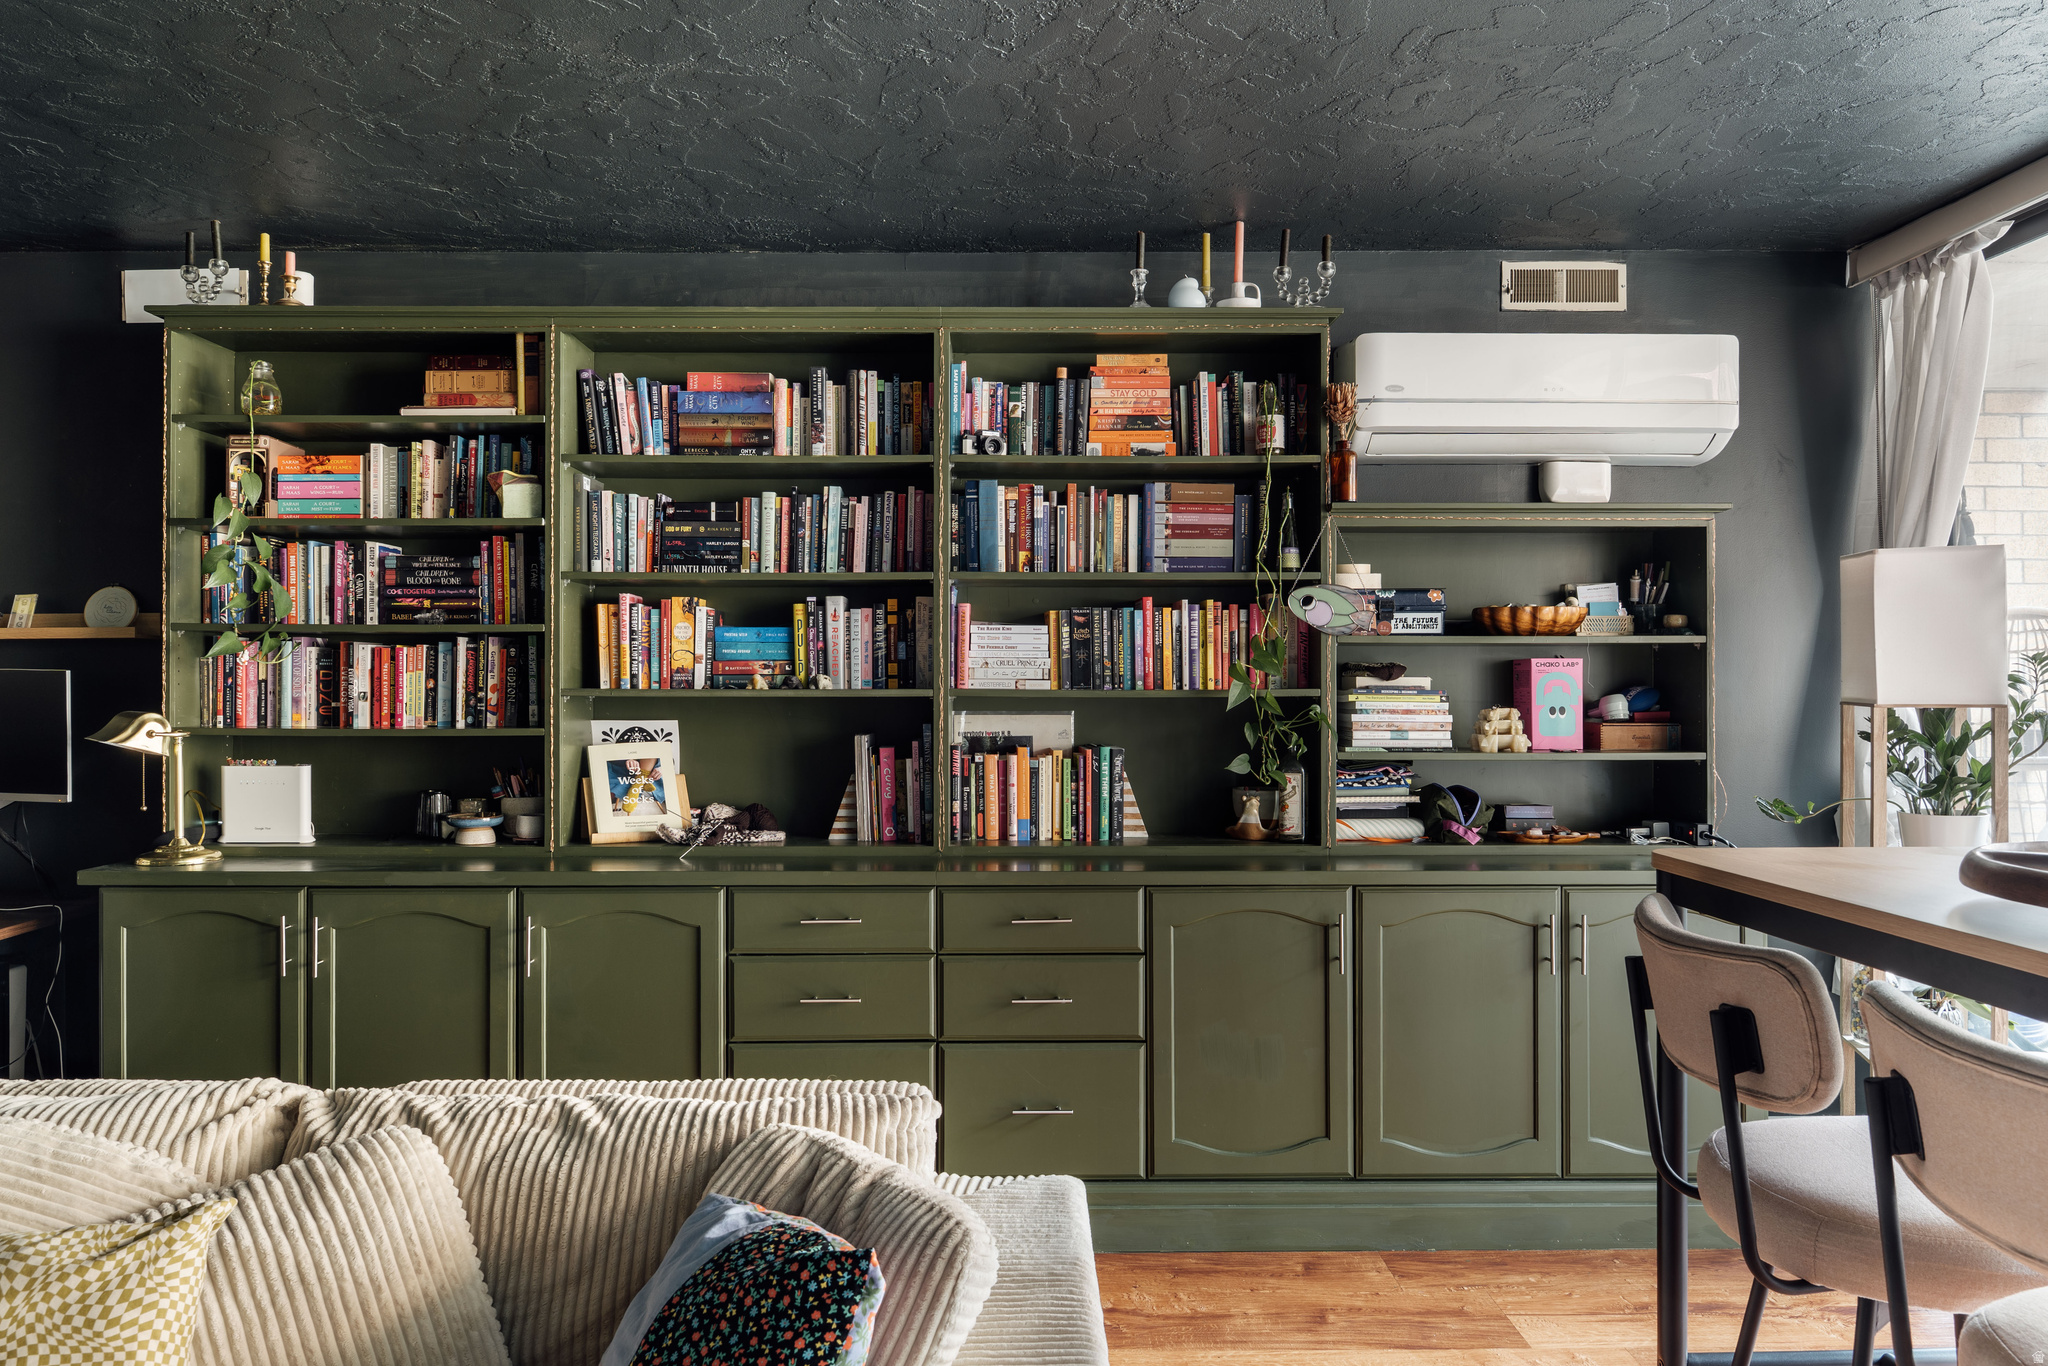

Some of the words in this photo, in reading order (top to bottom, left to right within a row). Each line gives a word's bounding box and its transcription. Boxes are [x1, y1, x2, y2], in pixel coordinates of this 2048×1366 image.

[893, 404, 899, 412] OF
[389, 461, 397, 490] LITTLE
[389, 491, 397, 510] LIFE
[884, 492, 893, 514] Never
[591, 511, 599, 527] NIGHT
[884, 515, 893, 543] Enough
[592, 530, 600, 555] TELEGRAPH
[673, 565, 699, 573] NINTH
[701, 565, 728, 573] HOUSE
[406, 577, 432, 585] BLOOD
[441, 577, 461, 585] BONE
[1190, 611, 1198, 622] THE
[641, 619, 650, 648] PATSY
[875, 609, 884, 648] REPRIEVE
[1190, 622, 1198, 637] WITCH
[831, 627, 839, 677] REACHED
[1190, 638, 1198, 650] KING
[235, 665, 243, 685] CRYING
[235, 699, 243, 716] MART
[951, 749, 960, 776] UNTRUE
[617, 776, 654, 784] Weeks
[632, 785, 644, 794] of
[622, 796, 654, 805] Socks
[988, 816, 995, 826] US
